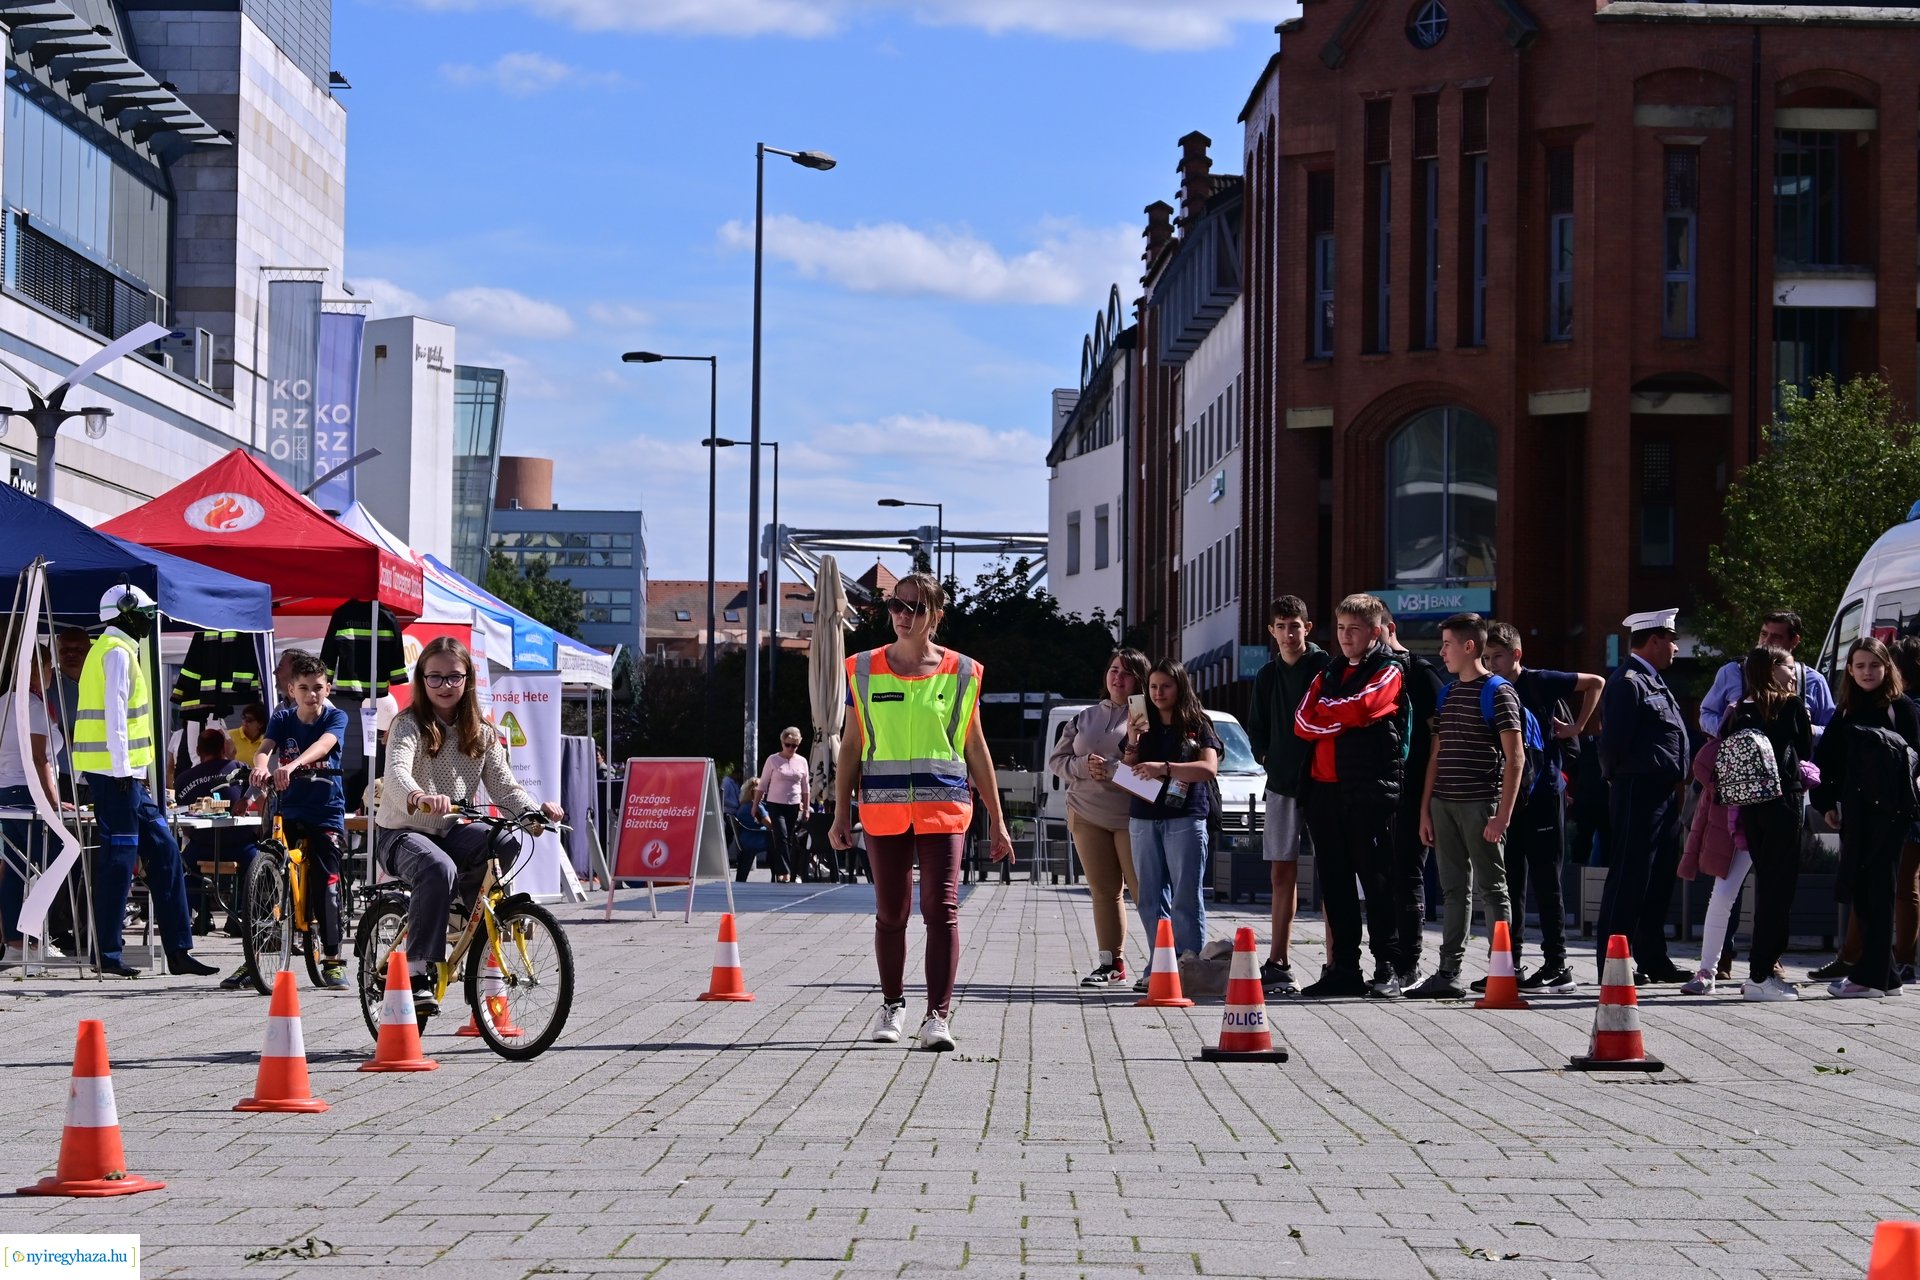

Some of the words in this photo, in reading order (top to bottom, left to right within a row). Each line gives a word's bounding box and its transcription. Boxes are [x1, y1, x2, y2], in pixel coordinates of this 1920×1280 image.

[272, 380, 312, 400] KO
[271, 408, 309, 429] RZ
[316, 404, 351, 424] KO
[1398, 594, 1429, 611] MBH
[1431, 594, 1462, 608] BANK
[492, 691, 520, 704] onság
[522, 691, 549, 702] Hete
[518, 778, 542, 786] etében
[629, 793, 671, 806] Országos
[625, 818, 669, 831] Bizottság
[1223, 1011, 1264, 1026] POLICE
